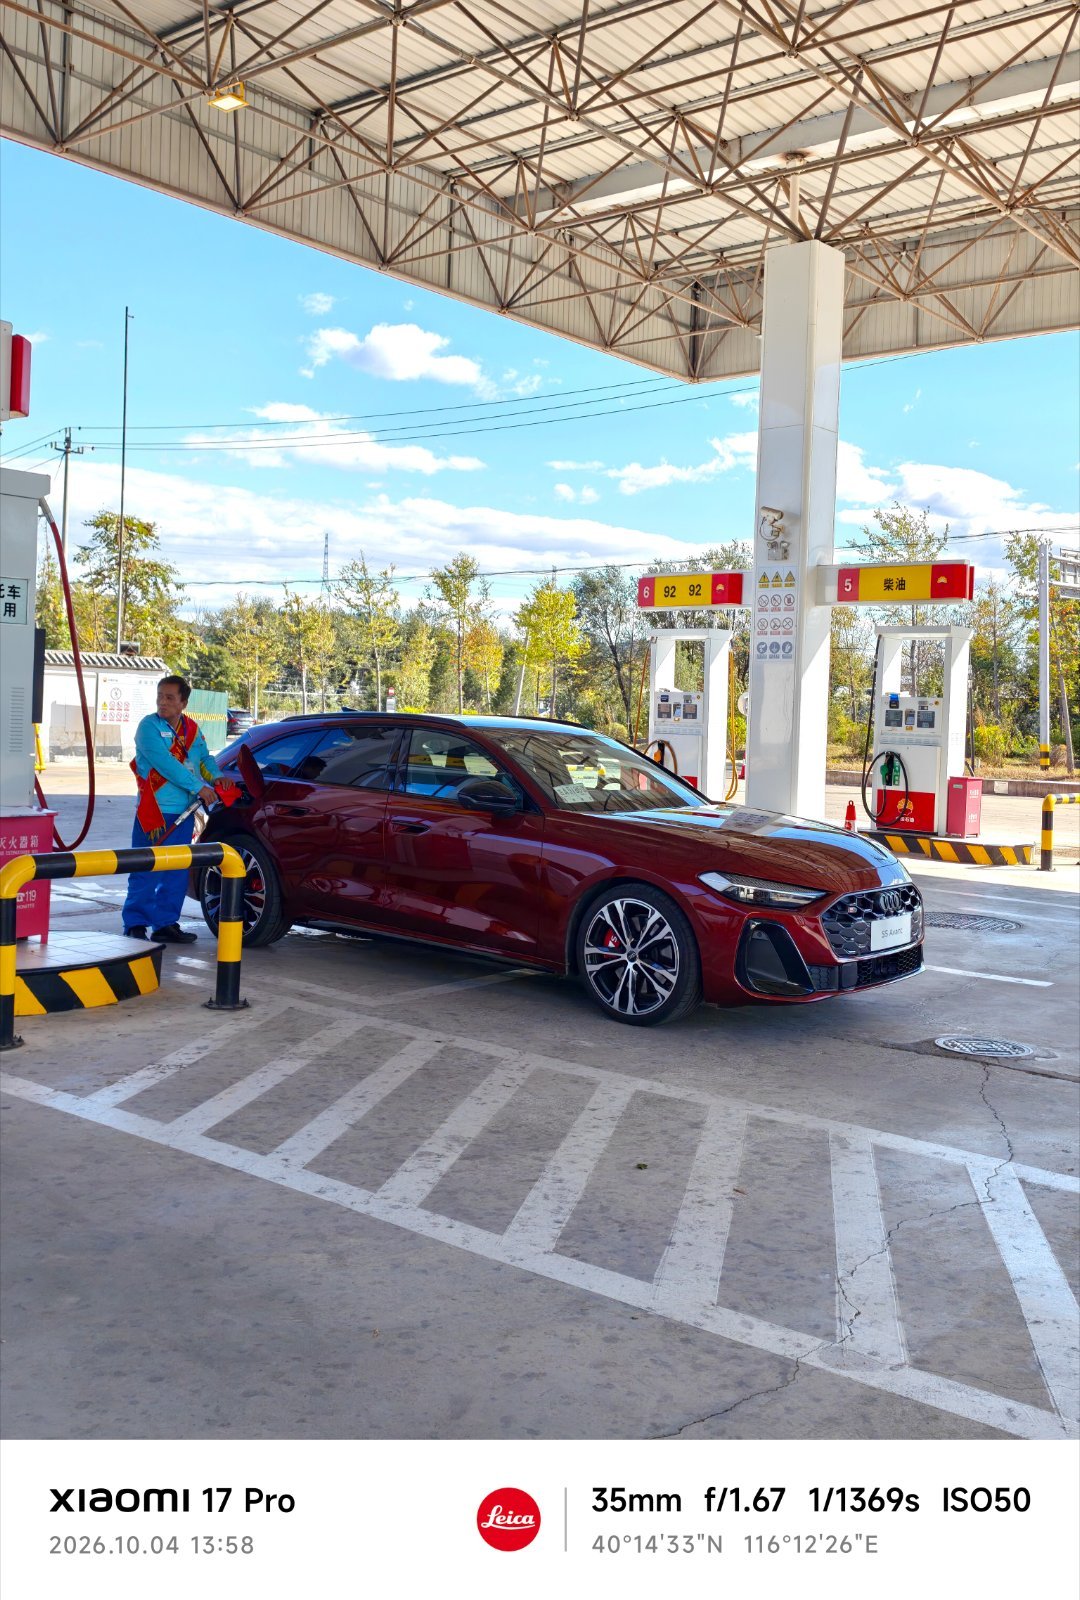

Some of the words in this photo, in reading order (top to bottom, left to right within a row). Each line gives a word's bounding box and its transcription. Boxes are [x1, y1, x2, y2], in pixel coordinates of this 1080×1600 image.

[643, 586, 650, 598] 6
[663, 586, 676, 598] 92
[689, 584, 702, 597] 92
[844, 578, 853, 592] 5
[883, 577, 906, 592] 柴油
[4, 603, 16, 617] 用
[25, 890, 37, 901] 119
